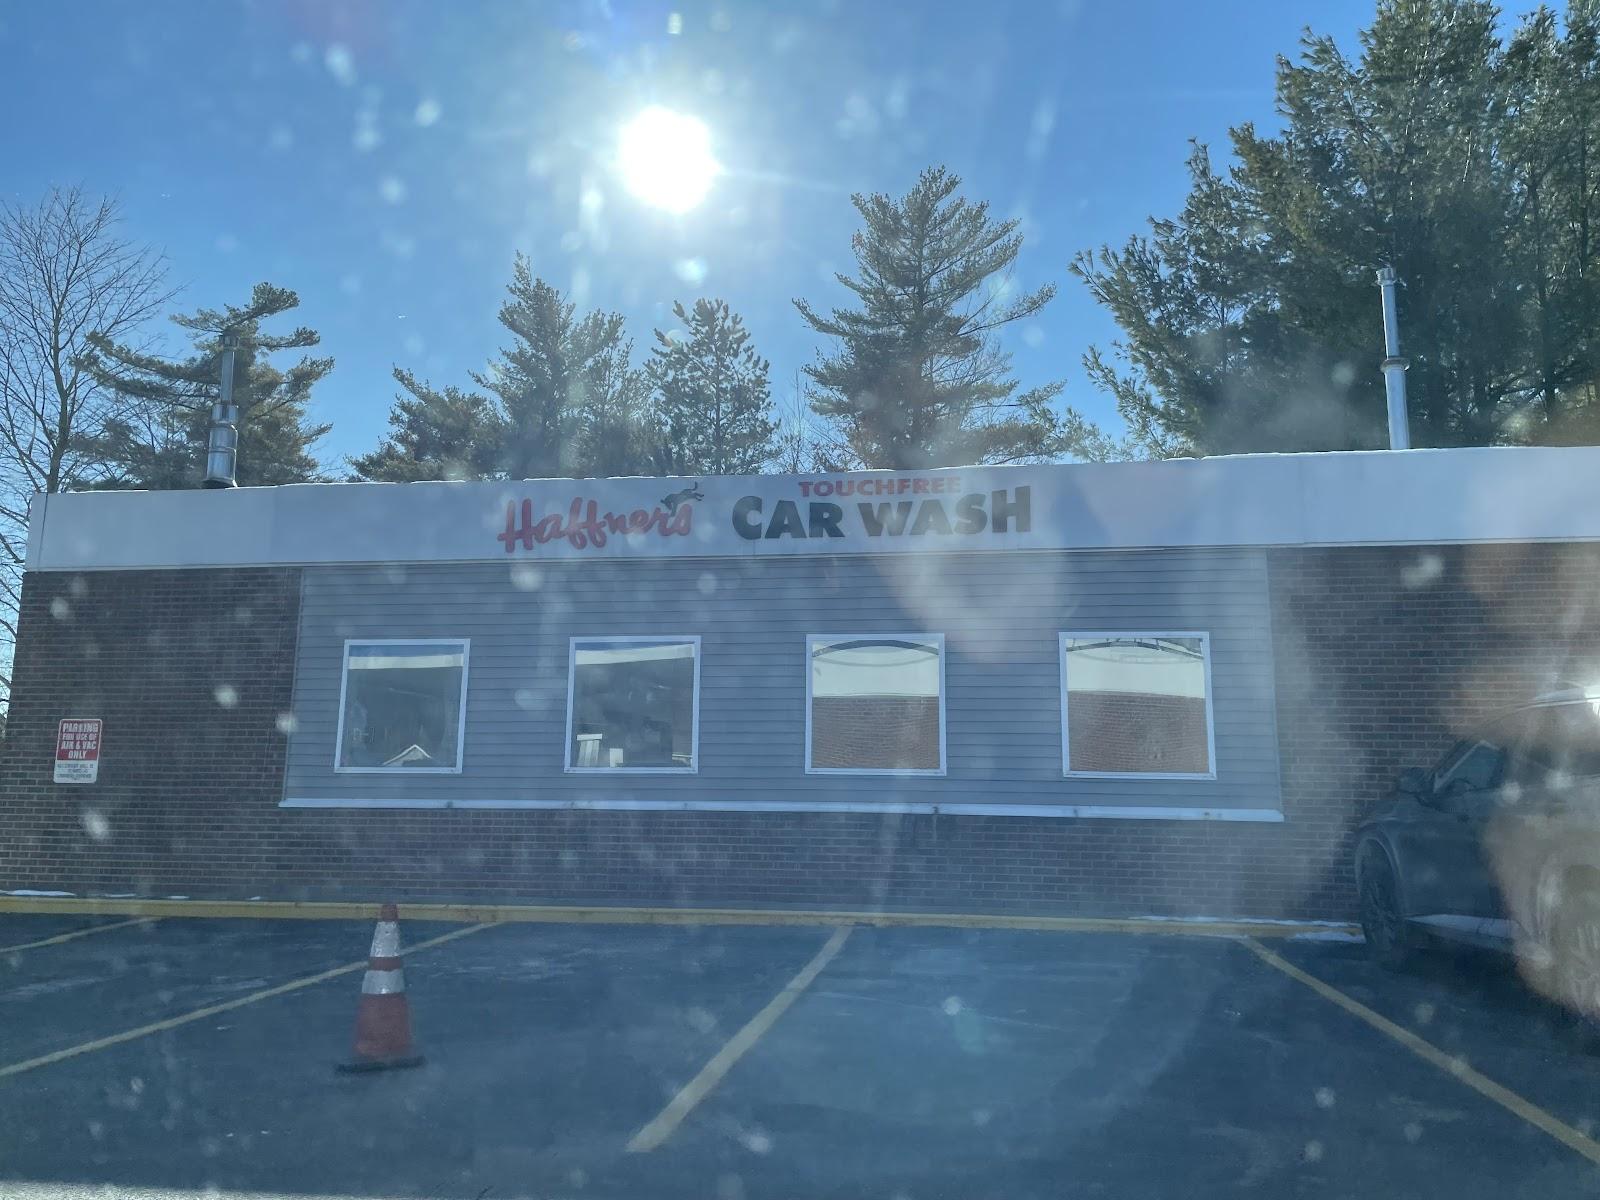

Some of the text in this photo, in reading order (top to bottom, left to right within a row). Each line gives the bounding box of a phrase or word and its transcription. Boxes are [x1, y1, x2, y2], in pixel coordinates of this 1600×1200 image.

[798, 476, 962, 498] TOUCHFREE
[732, 485, 1032, 540] CAR WASH
[62, 722, 98, 732] PARKING
[61, 741, 74, 750] AIR
[82, 741, 96, 750] VAC
[68, 750, 87, 759] ONLY
